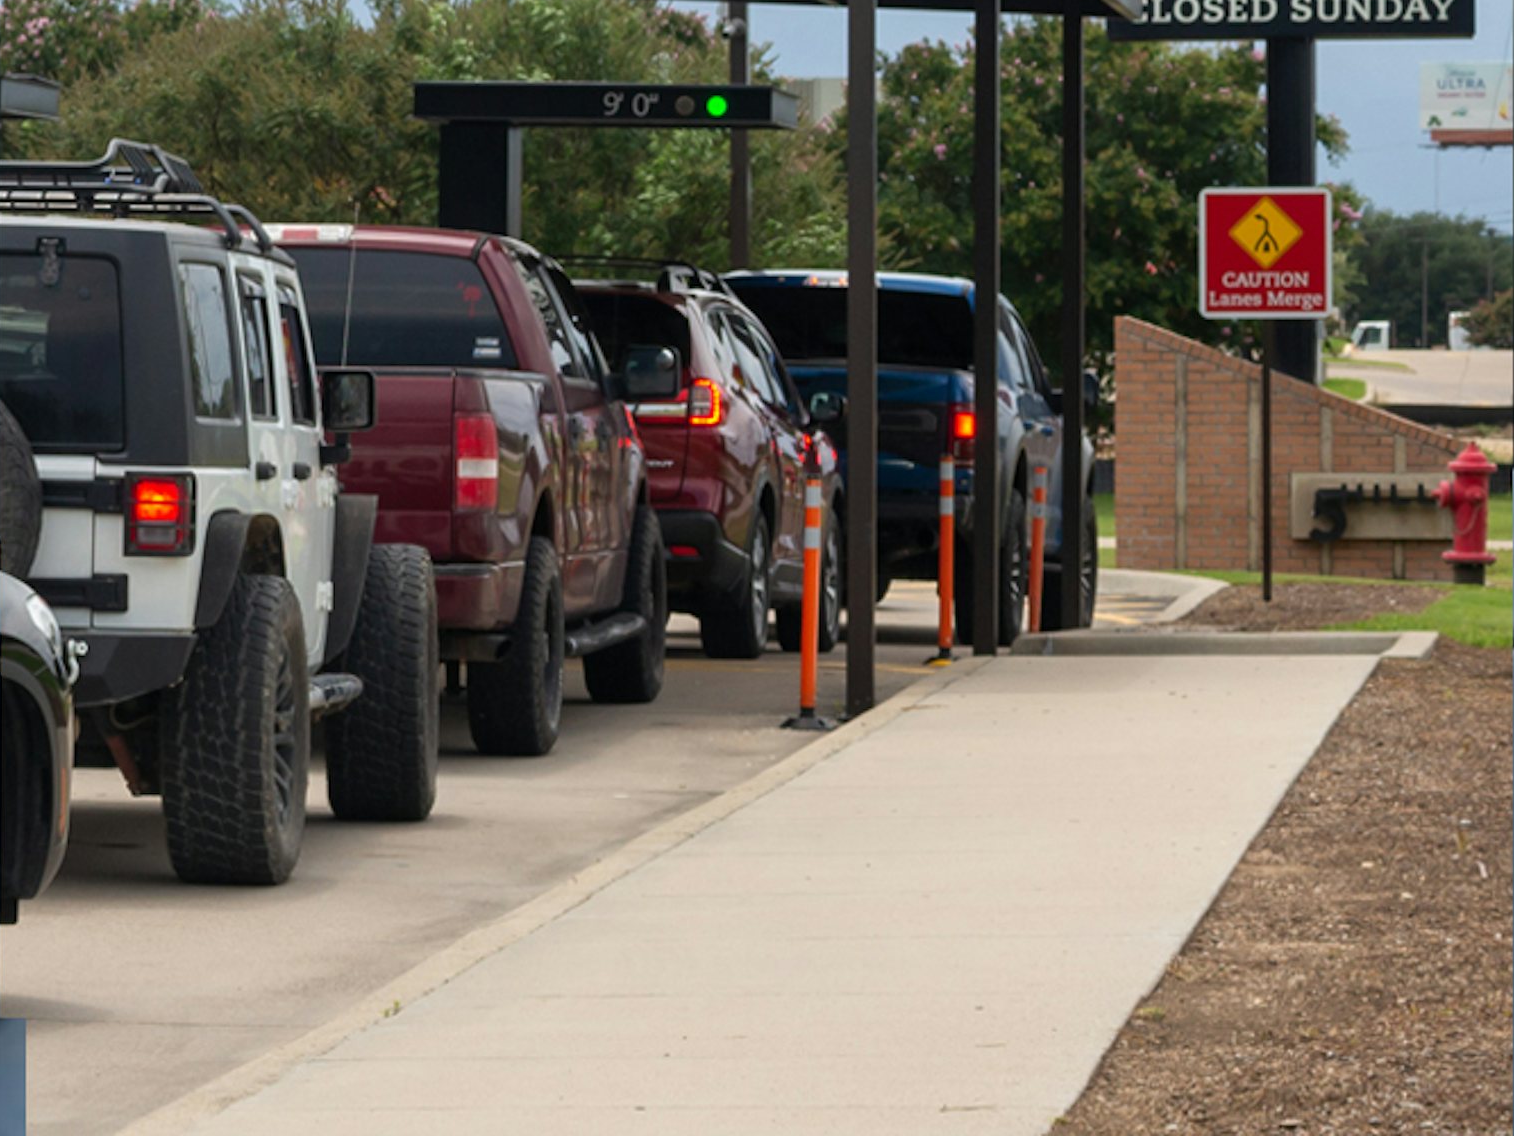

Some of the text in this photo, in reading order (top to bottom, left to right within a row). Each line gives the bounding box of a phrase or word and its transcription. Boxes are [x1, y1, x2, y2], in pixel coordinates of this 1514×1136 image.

[1436, 77, 1486, 90] ULTRA
[1221, 271, 1310, 288] CAUTION
[1208, 290, 1323, 311] Lanes Merge
